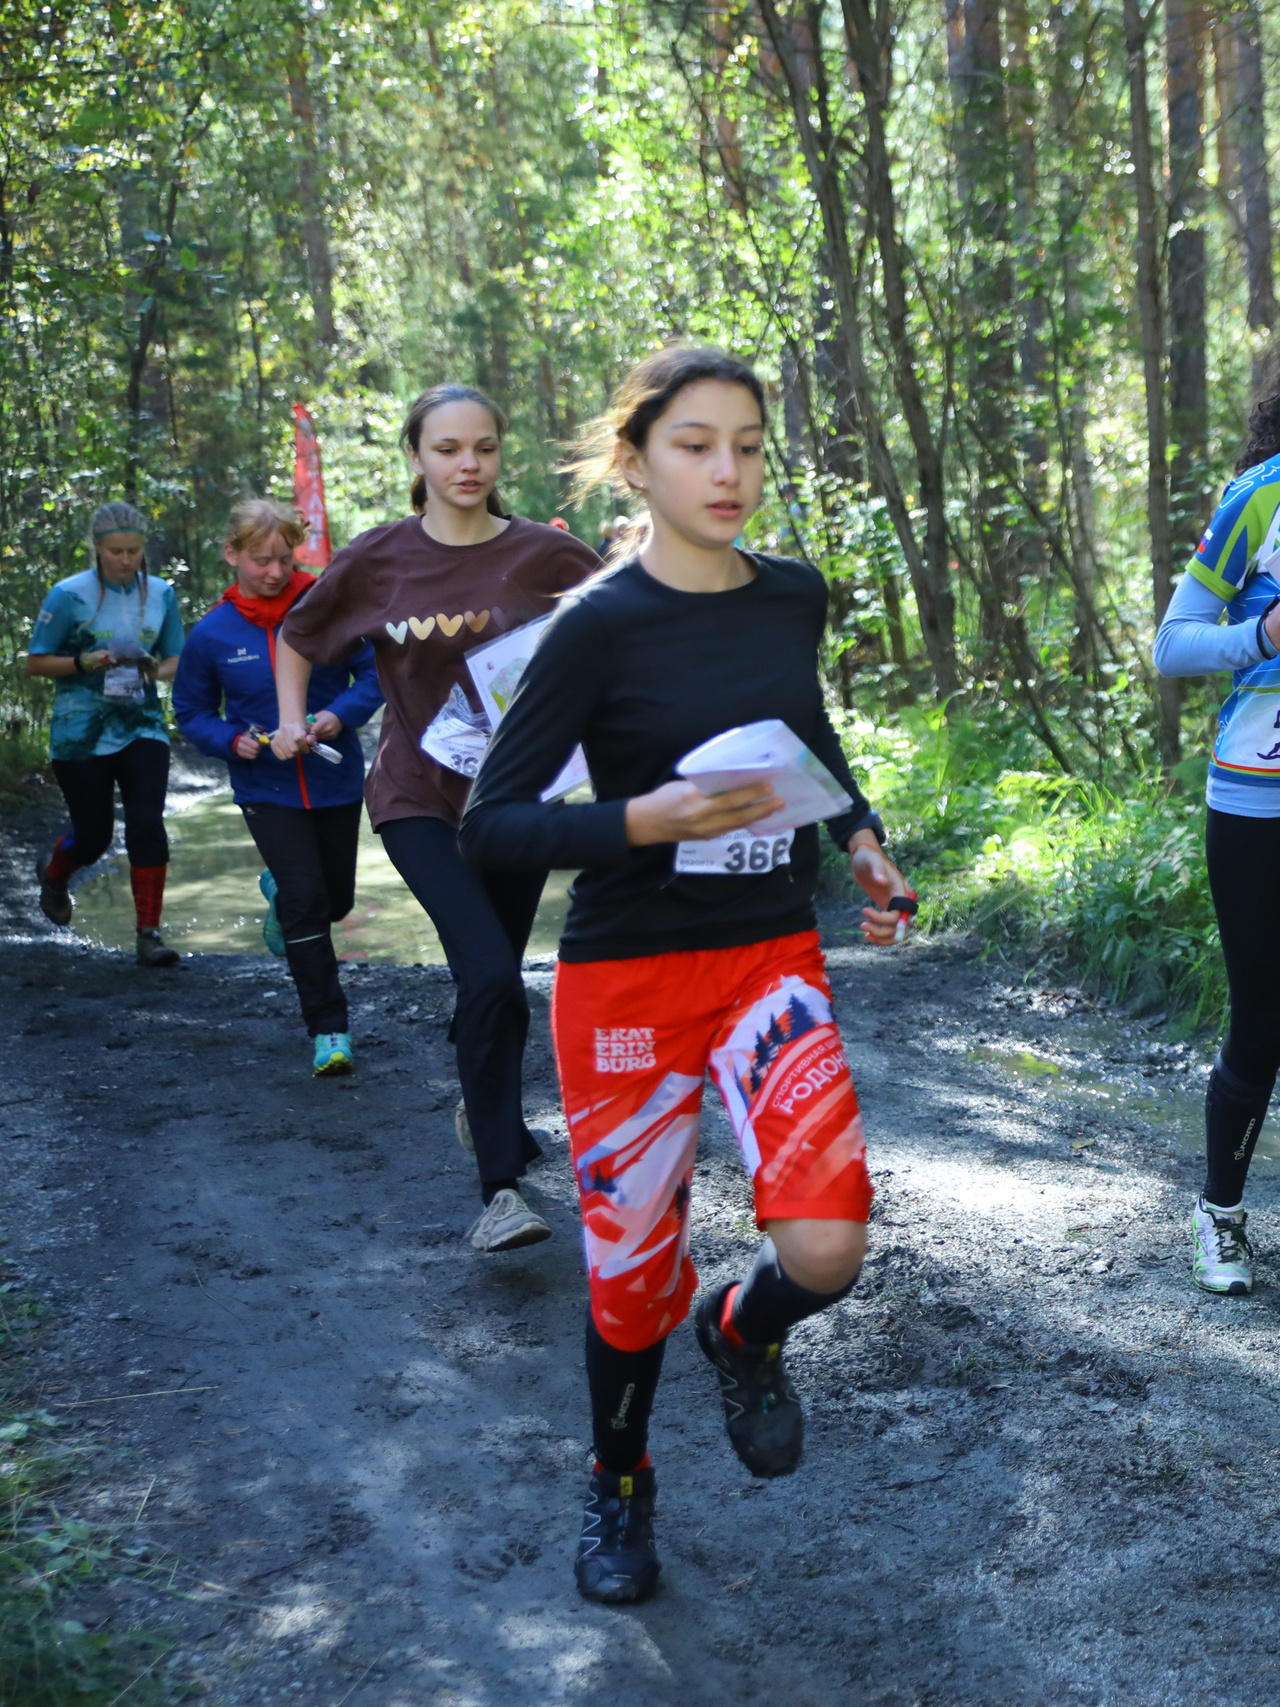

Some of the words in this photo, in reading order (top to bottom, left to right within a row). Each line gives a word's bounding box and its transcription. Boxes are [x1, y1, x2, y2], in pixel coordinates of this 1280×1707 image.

[450, 753, 479, 776] 36
[595, 1027, 656, 1041] EKAT
[595, 1041, 656, 1056] ERIN
[596, 1053, 657, 1073] BURG
[772, 1044, 828, 1108] СПОРТИВНАЯ
